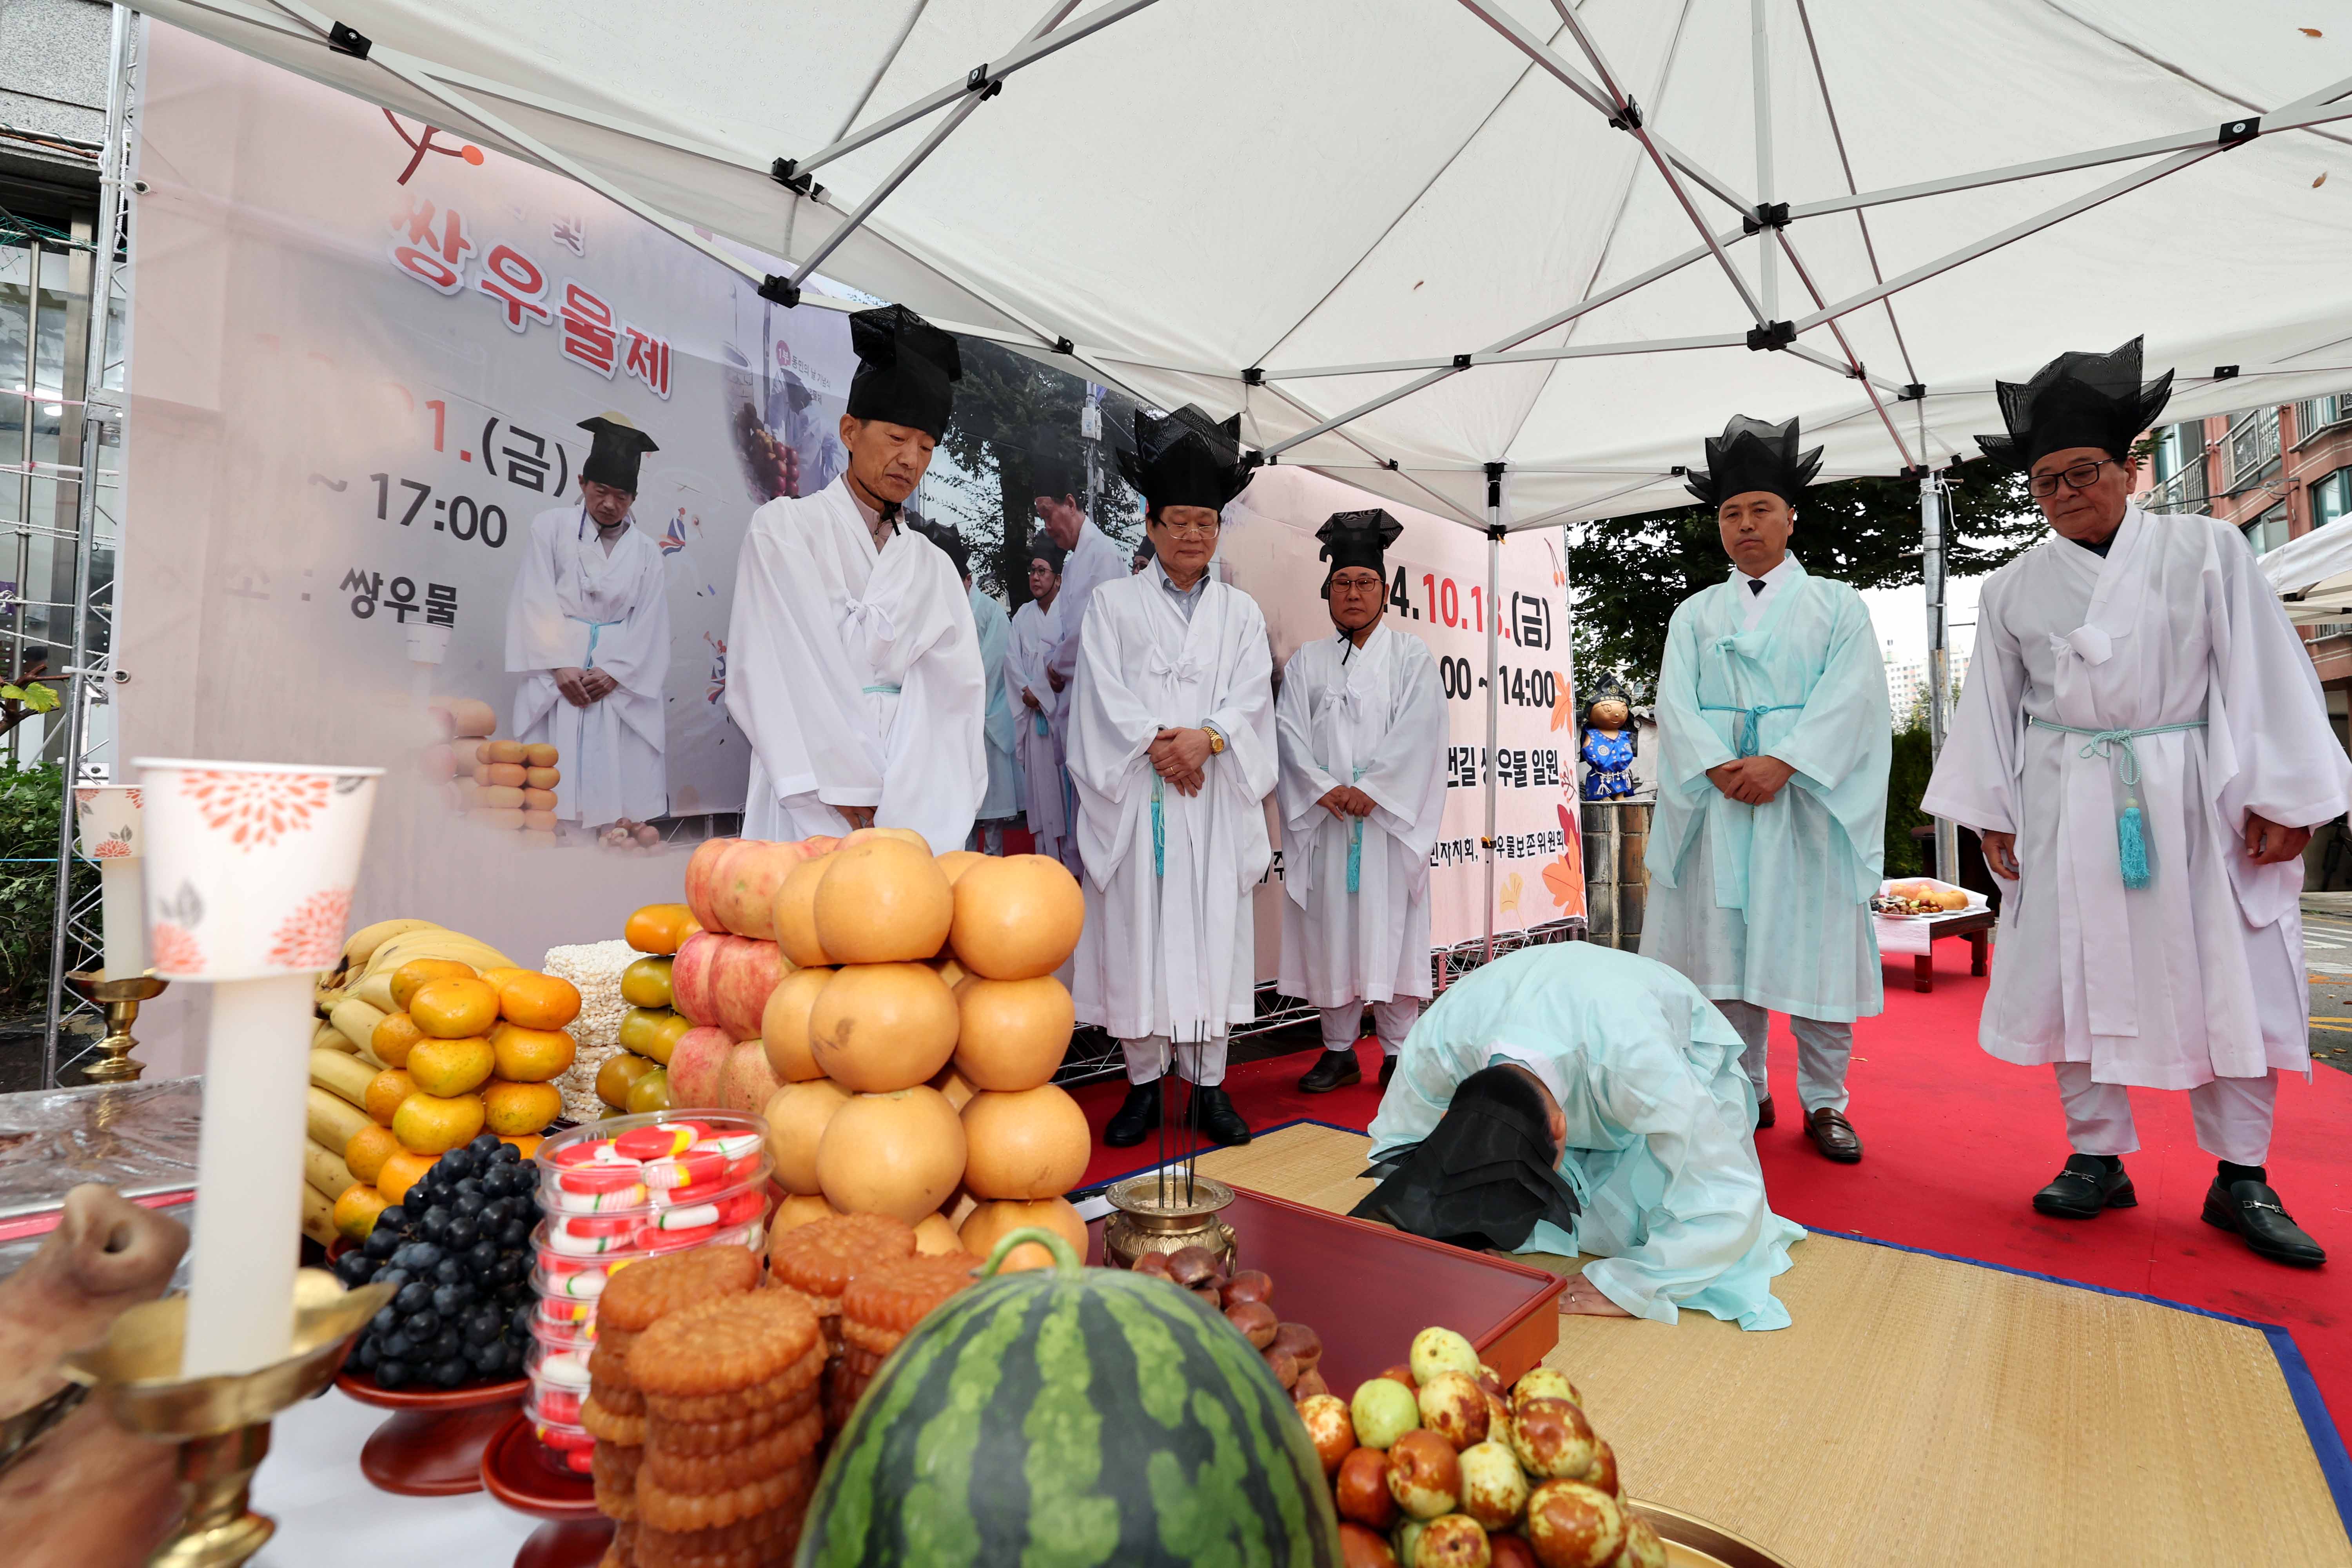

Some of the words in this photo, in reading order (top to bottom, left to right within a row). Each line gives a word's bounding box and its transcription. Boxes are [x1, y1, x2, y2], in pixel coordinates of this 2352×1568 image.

[390, 194, 669, 394] 쌍우물제
[792, 356, 809, 376] 동민의
[370, 472, 507, 548] 17:00
[339, 567, 458, 629] 쌍우물
[1499, 665, 1555, 708] 14:00
[1532, 749, 1559, 786] 일원
[1496, 830, 1564, 858] 우물보존위원회
